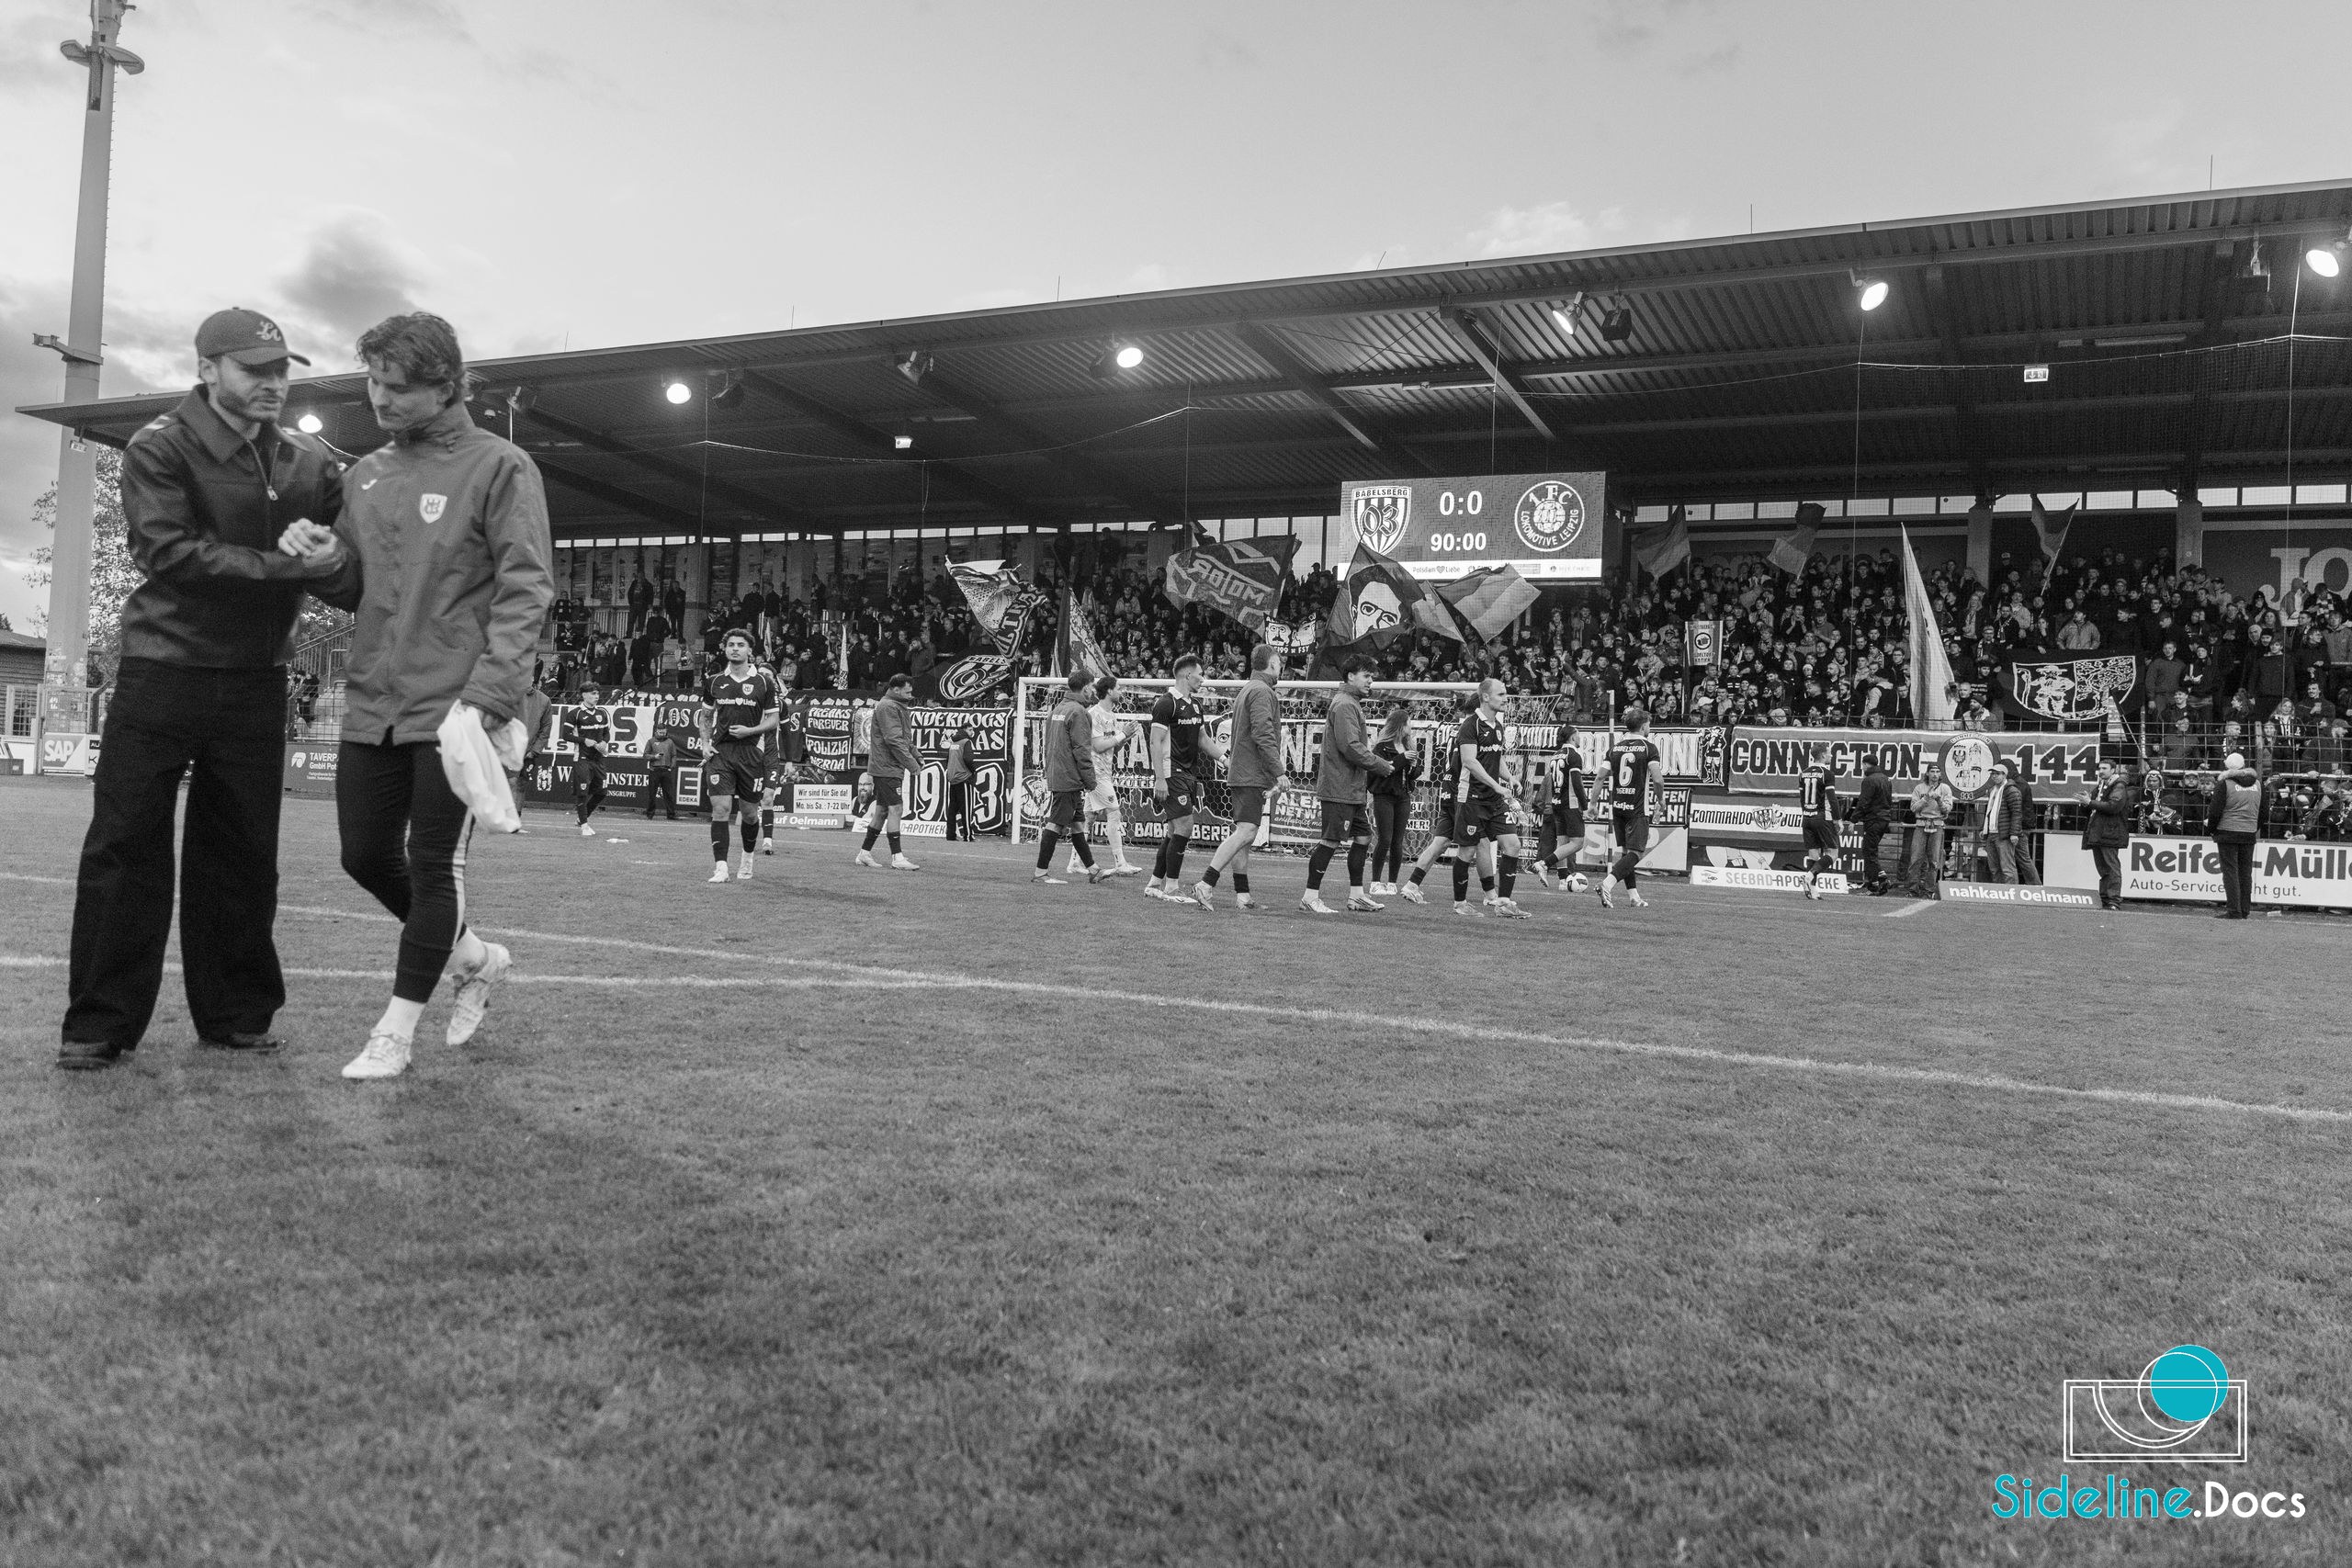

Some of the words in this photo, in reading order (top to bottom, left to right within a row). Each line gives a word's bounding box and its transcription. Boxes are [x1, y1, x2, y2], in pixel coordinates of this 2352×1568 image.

[1355, 489, 1408, 498] BABELSBERG
[1439, 491, 1483, 515] 0:0
[1360, 504, 1399, 537] 03
[1521, 511, 1558, 546] LOKOMOTIVE
[1559, 509, 1579, 541] LEIPZIG
[1430, 533, 1487, 551] 90:00
[808, 718, 849, 731] FOREVER
[44, 739, 74, 761] SAP
[808, 739, 848, 755] POLIZIA
[310, 752, 339, 761] TAVERP
[1731, 739, 1922, 780] CONNCTION
[1619, 752, 1635, 786] 6
[798, 789, 808, 797] Wir
[808, 789, 820, 797] sind
[821, 789, 830, 797] für
[831, 789, 840, 797] Sie
[840, 789, 848, 797] da!
[1804, 778, 1817, 805] 11
[1613, 800, 1634, 810] Katjes
[790, 816, 838, 826] Oelmann
[1691, 809, 1753, 825] COMMANDO
[2131, 841, 2352, 880] Reife-Müll
[1725, 872, 1840, 890] SEEBAD-APOEKE
[1949, 886, 2016, 902] nahkauf
[2020, 889, 2093, 905] Oelmann
[2273, 886, 2301, 898] gut.
